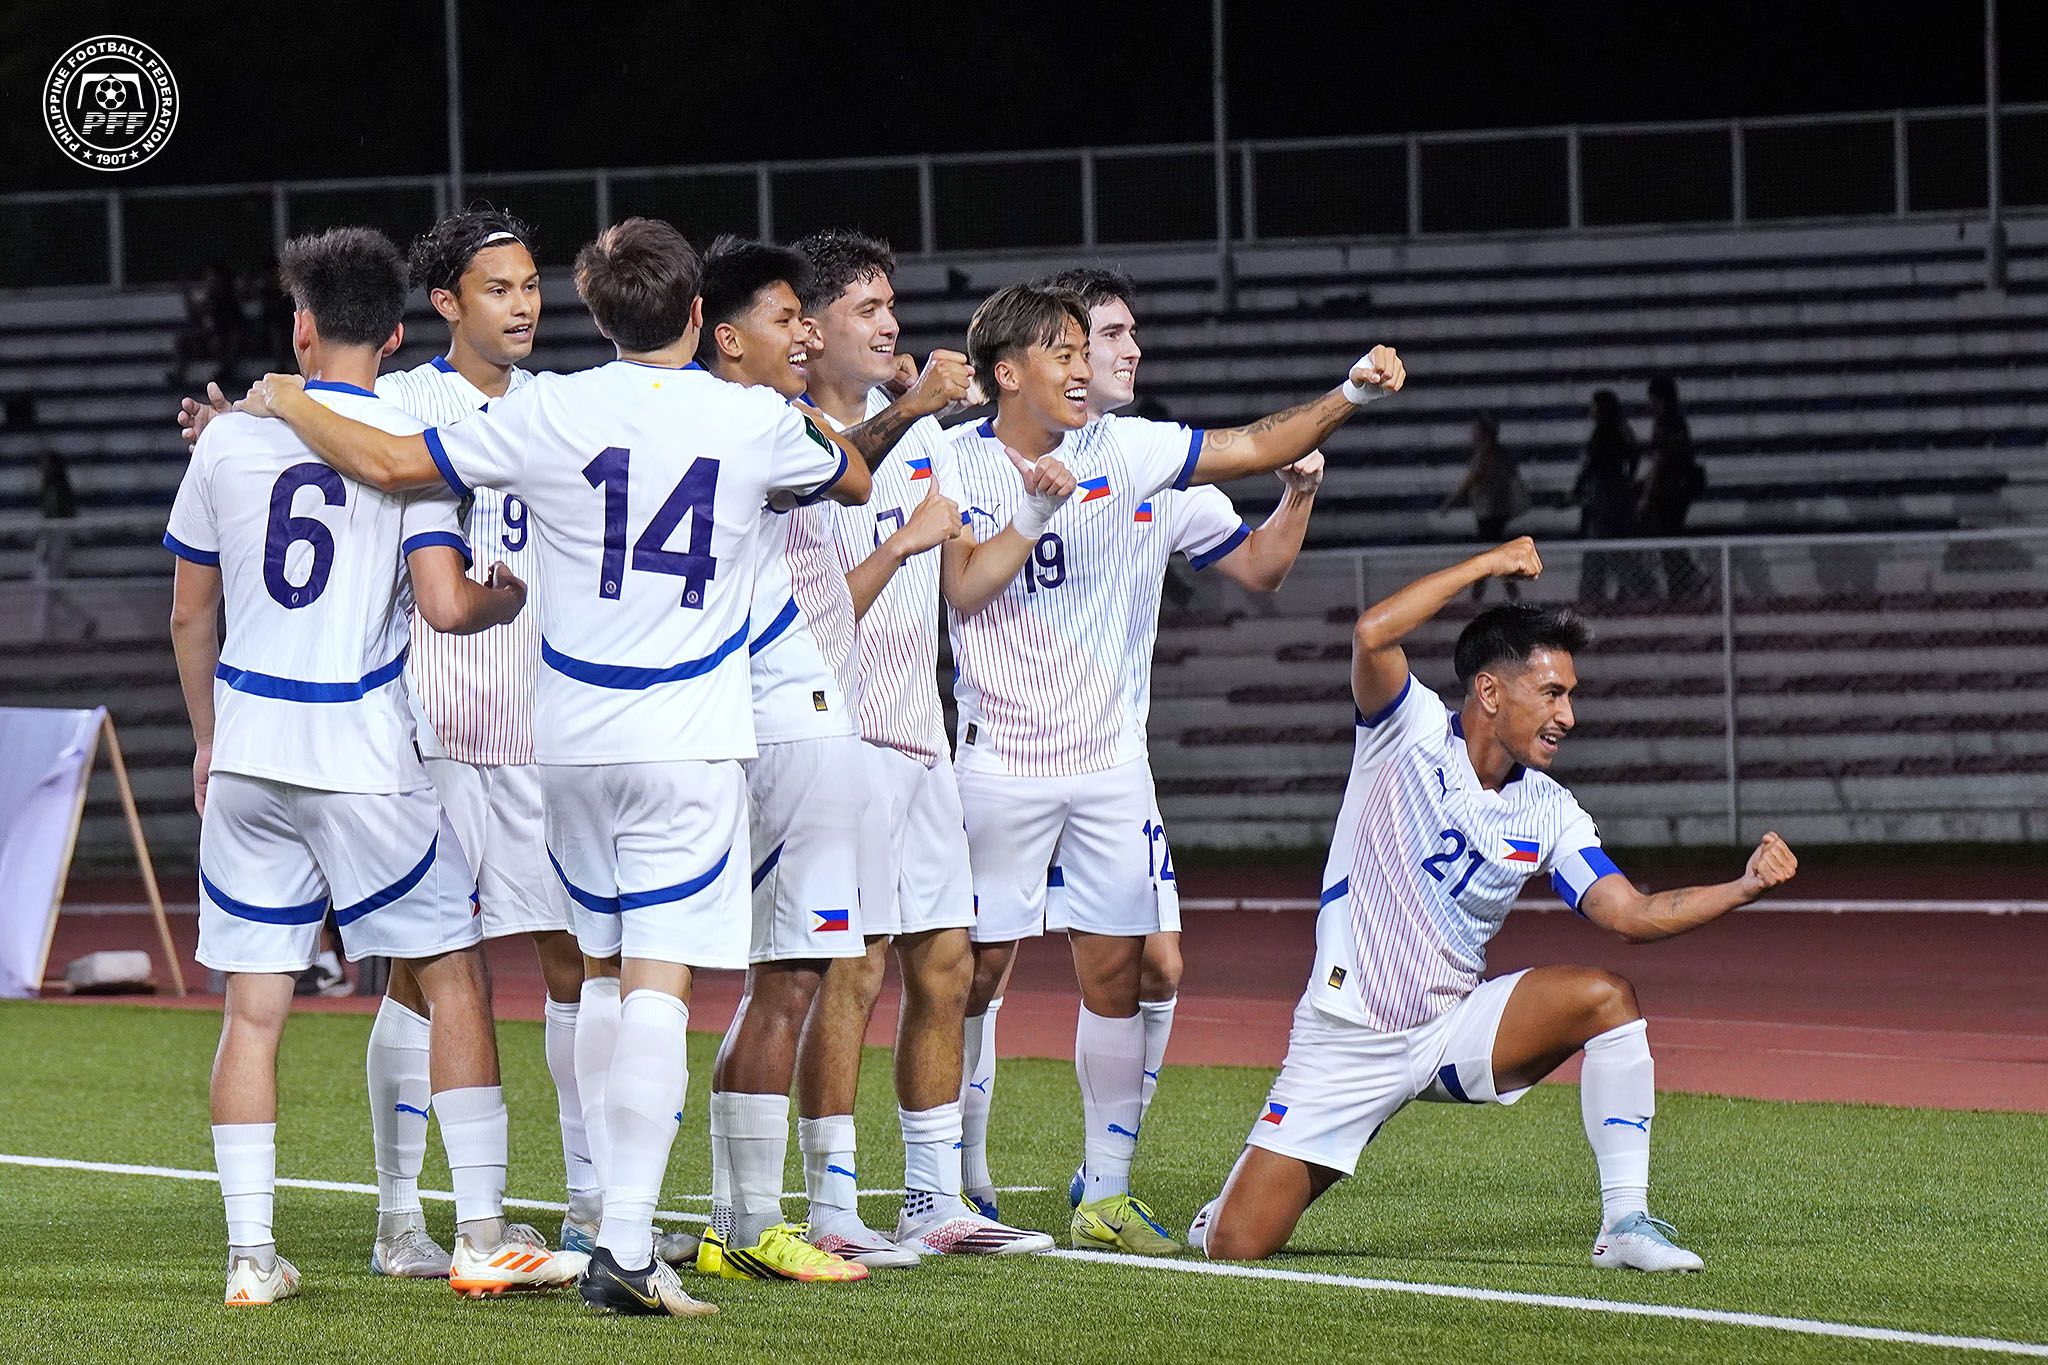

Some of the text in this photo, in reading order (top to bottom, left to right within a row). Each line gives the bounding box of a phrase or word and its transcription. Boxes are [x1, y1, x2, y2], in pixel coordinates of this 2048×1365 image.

[263, 462, 347, 610] 6
[501, 494, 528, 552] 9
[581, 446, 720, 611] 14
[1420, 828, 1486, 899] 21
